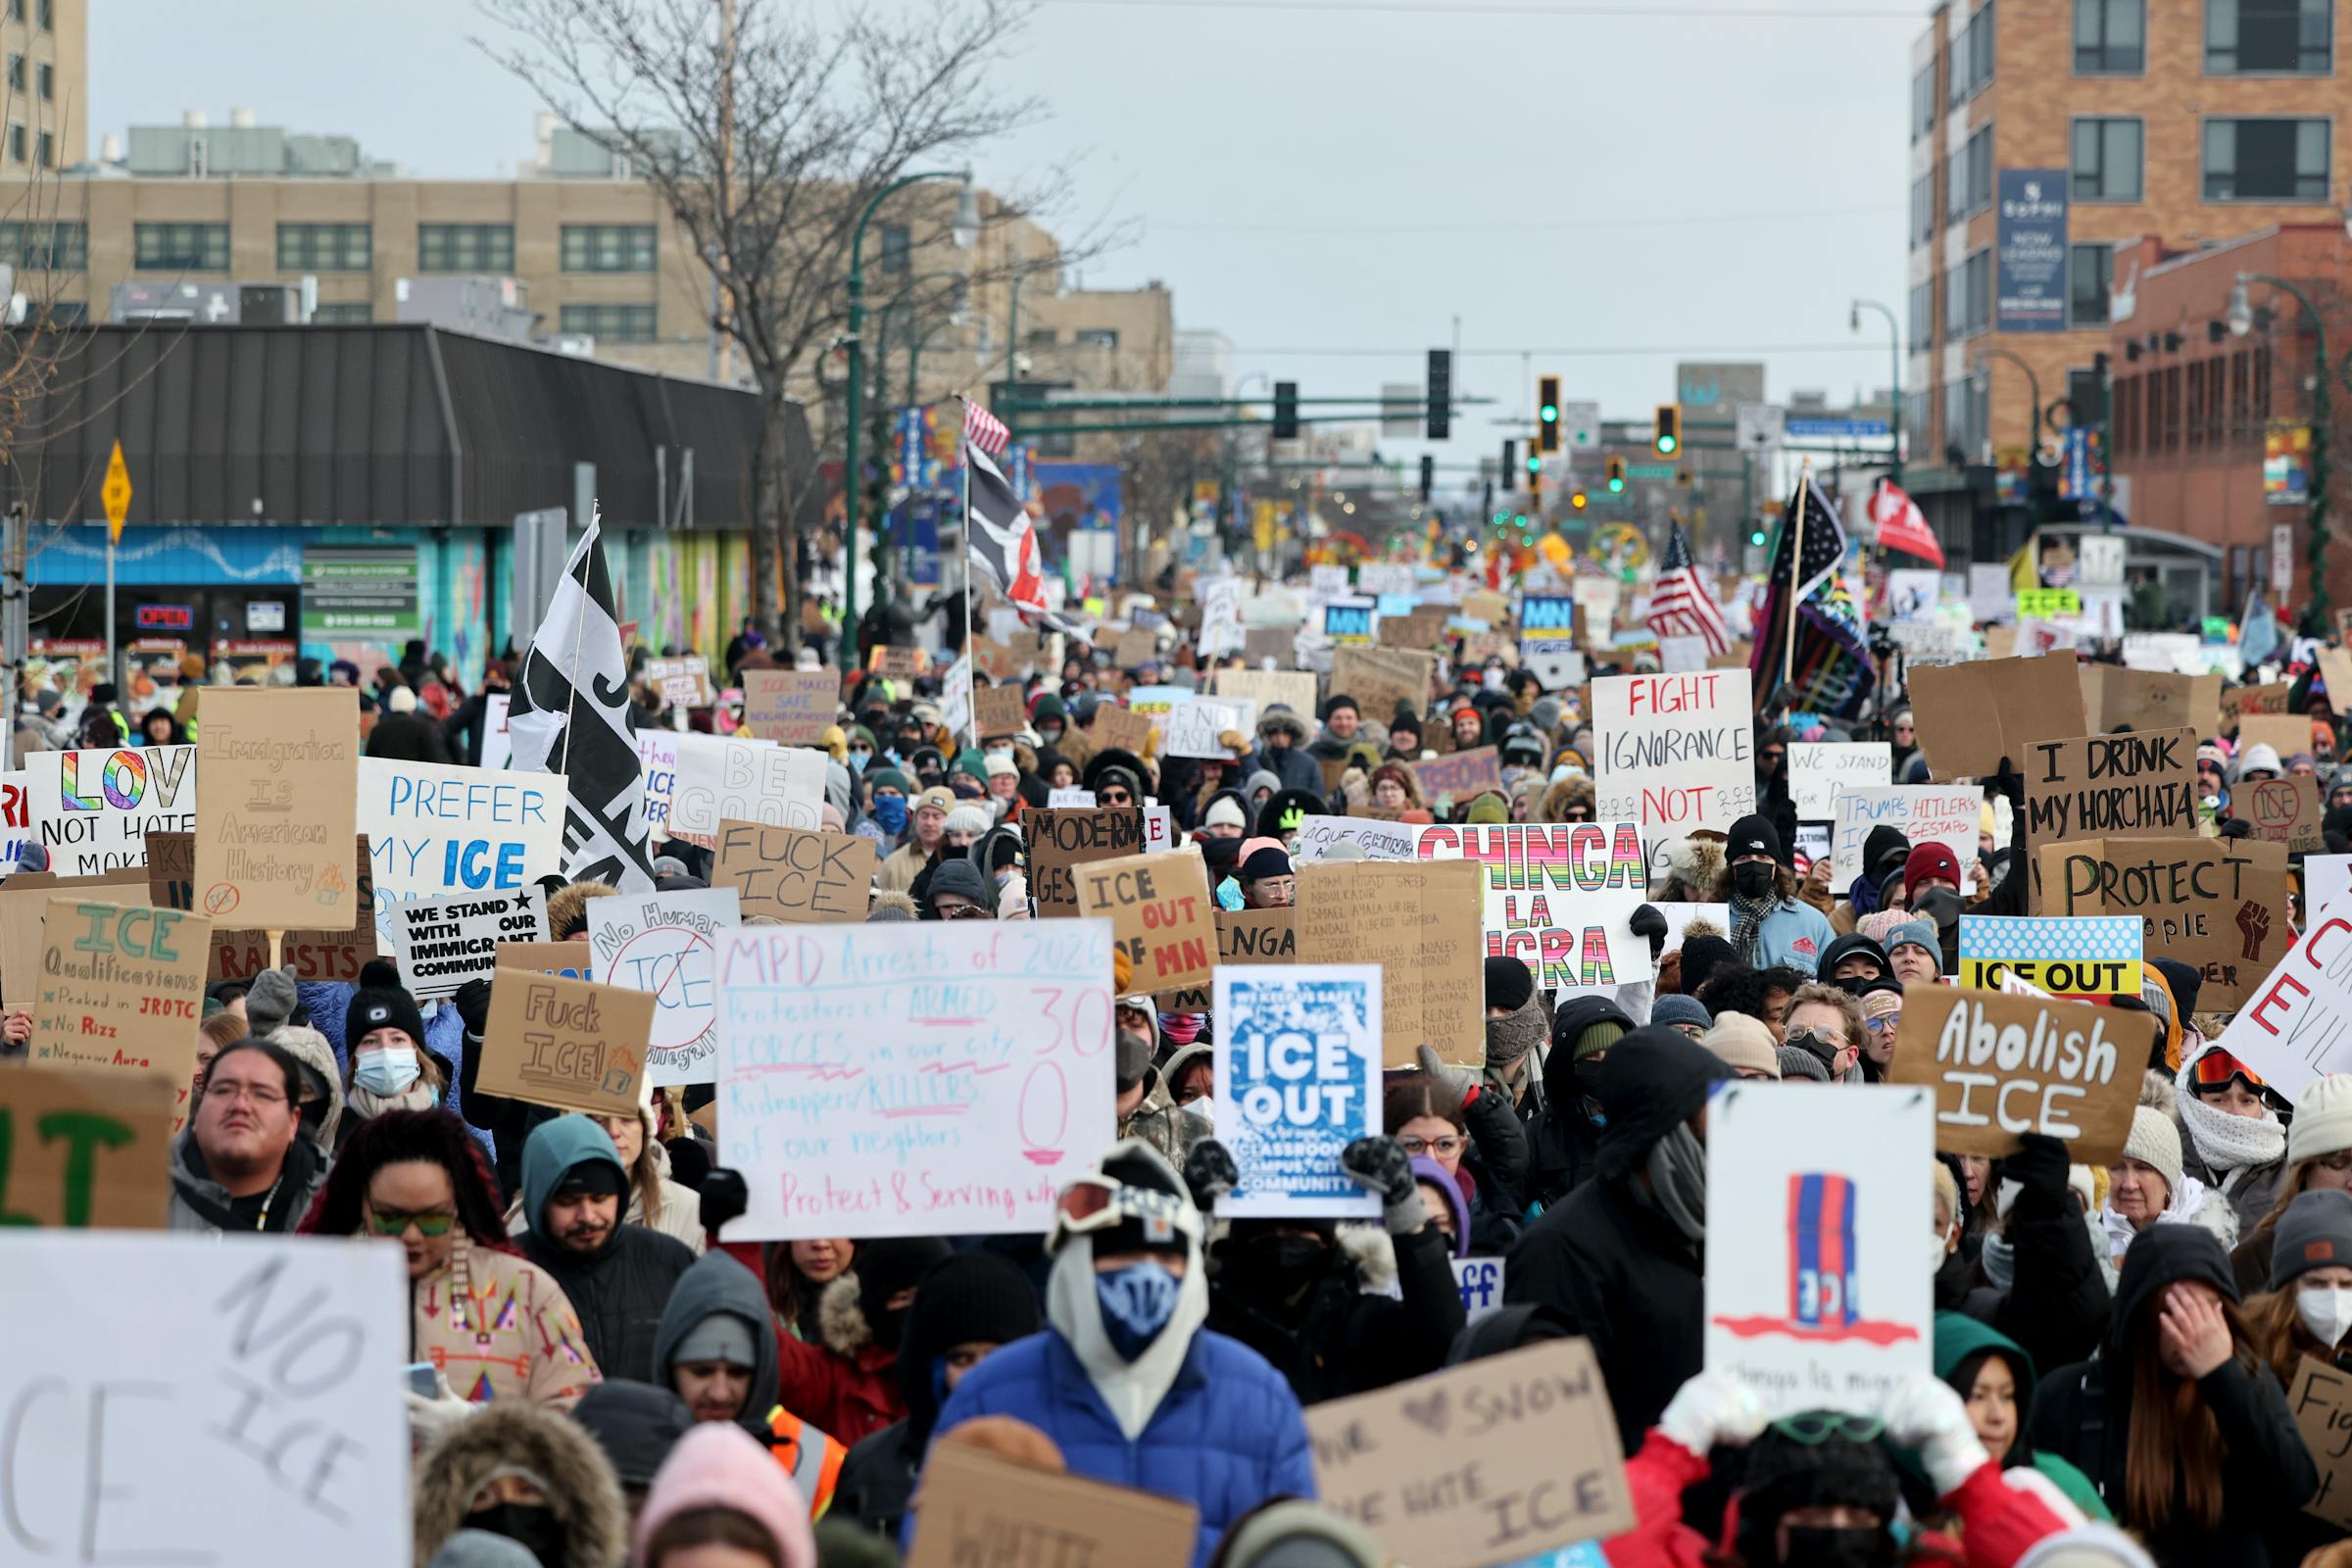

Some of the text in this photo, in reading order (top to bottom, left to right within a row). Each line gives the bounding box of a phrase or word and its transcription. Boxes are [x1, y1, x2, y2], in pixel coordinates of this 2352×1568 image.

[140, 606, 190, 627] OPEN
[1327, 608, 1369, 634] MN
[1523, 599, 1572, 628] MN
[2023, 595, 2072, 610] ICE
[775, 695, 811, 710] SAFE
[1630, 675, 1720, 715] FIGHT
[204, 725, 345, 772] Immigration
[1605, 728, 1749, 774] IGNORANCE
[1791, 746, 1889, 770] WE STAND
[2037, 737, 2183, 782] I DRINK
[61, 747, 196, 810] LOV
[724, 744, 790, 797] BE
[389, 775, 547, 825] PREFER
[1642, 786, 1713, 825] NOT
[2030, 781, 2195, 838] MY HORCHATA
[2259, 789, 2294, 819] ICE
[41, 816, 100, 847] NOT
[219, 812, 327, 846] American
[1906, 820, 1969, 839] GESTAPO
[2288, 837, 2320, 851] ITIES
[78, 852, 149, 875] MAK
[225, 850, 316, 895] History
[368, 837, 526, 890] MY ICE
[722, 827, 856, 880] FUCK
[1418, 822, 1645, 891] CHINGA
[735, 868, 847, 913] ICE
[1036, 864, 1077, 906] GES
[1090, 868, 1156, 909] ICE
[2065, 853, 2253, 916] PROTECT
[405, 900, 509, 923] WE STAND
[408, 915, 537, 941] WITH OUR
[1142, 896, 1197, 930] OUT
[1505, 895, 1553, 929] LA
[74, 905, 184, 962] ICE
[592, 921, 636, 962] No
[44, 946, 199, 992] Qualifications
[219, 944, 360, 978] RAISTS
[413, 956, 496, 977] COMMUN
[724, 930, 1103, 988] MPD Arrests of 2026
[1153, 937, 1208, 978] MN
[1383, 958, 1406, 970] HITO
[1487, 926, 1616, 988] IGRA
[1975, 962, 2128, 991] ICE OUT
[624, 950, 713, 1009] ICE
[58, 986, 197, 1020] Peaked in JROTC
[525, 983, 602, 1034] Fuck
[863, 990, 890, 1019] of
[909, 985, 997, 1018] ARMED
[1030, 987, 1113, 1057] 30
[1422, 1007, 1465, 1022] RENEE
[54, 1014, 118, 1039] No Rizz
[731, 1027, 1013, 1064] FORCES in our city
[1422, 1021, 1467, 1038] NICOLE
[1432, 1036, 1456, 1053] OOD
[1936, 998, 2118, 1085] Abolish
[112, 1049, 150, 1068] Aura
[520, 1032, 606, 1082] ICE!
[1248, 1032, 1350, 1081] ICE
[1241, 1084, 1356, 1127] OUT
[1936, 1071, 2086, 1140] ICE
[731, 1120, 961, 1166] of our neighbors
[1238, 1142, 1345, 1157] CLASSROO
[1238, 1177, 1355, 1193] COMMUNITY
[1313, 1159, 1340, 1174] CIT
[780, 1174, 883, 1219] Protect
[922, 1170, 1016, 1220] Serving
[1026, 1178, 1058, 1205] wh
[1458, 1262, 1497, 1310] ff
[214, 1253, 367, 1400] NO
[1461, 1364, 1592, 1438] SNOW
[2297, 1373, 2352, 1457] Fig
[202, 1366, 368, 1529] ICE
[2, 1375, 218, 1564] CE
[1401, 1460, 1483, 1517] HATE
[1484, 1469, 1610, 1549] ICE
